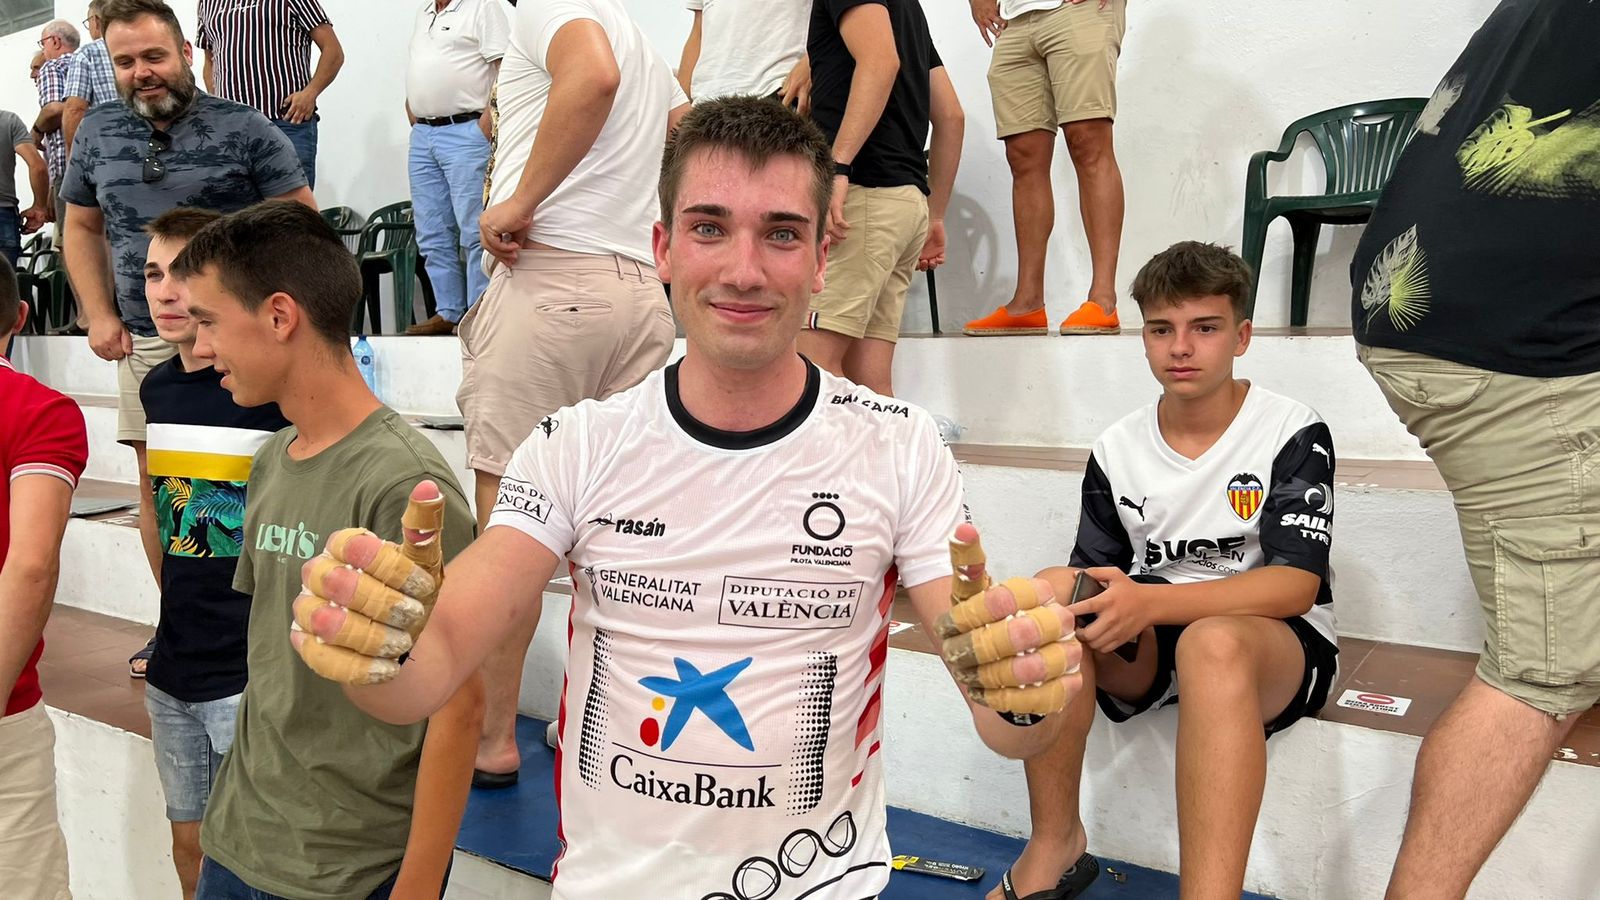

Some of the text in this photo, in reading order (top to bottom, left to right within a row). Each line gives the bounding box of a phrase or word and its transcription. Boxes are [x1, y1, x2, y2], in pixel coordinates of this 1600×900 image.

[496, 493, 541, 518] NCIA
[615, 517, 666, 536] rasán
[790, 557, 852, 567] PILOTA VALENCIANA
[600, 569, 702, 596] GENERALITAT
[729, 583, 857, 599] DIPUTACIÓ DE
[601, 583, 695, 613] VALENCIANA
[728, 600, 852, 620] VALÈNCIA
[610, 754, 776, 809] CaixaBank
